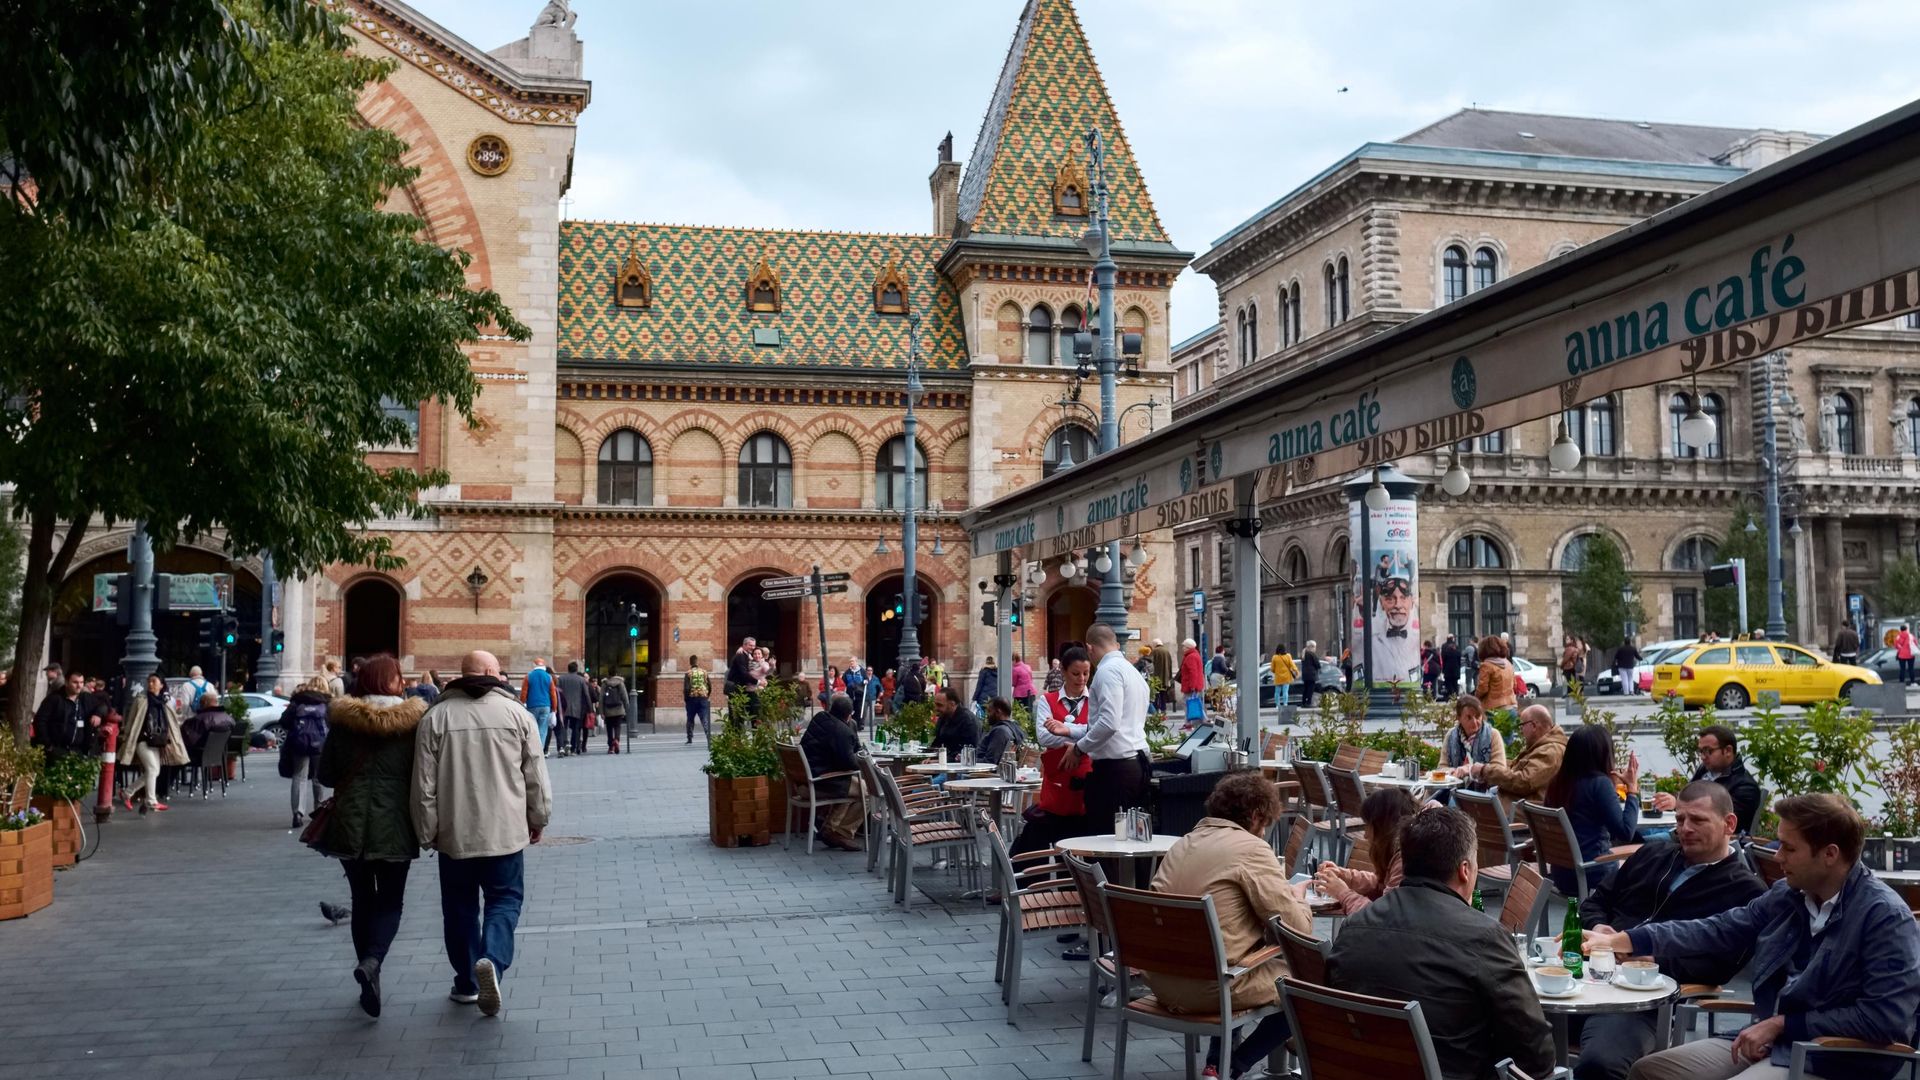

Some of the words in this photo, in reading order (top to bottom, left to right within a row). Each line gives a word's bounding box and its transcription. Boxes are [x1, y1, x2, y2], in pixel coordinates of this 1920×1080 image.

[1565, 300, 1670, 375] anna
[1684, 233, 1806, 335] café
[1268, 419, 1323, 465] anna
[1329, 388, 1381, 446] café
[1087, 494, 1117, 524] anna
[1120, 473, 1149, 513] café
[995, 528, 1015, 550] anna
[1015, 512, 1035, 545] café
